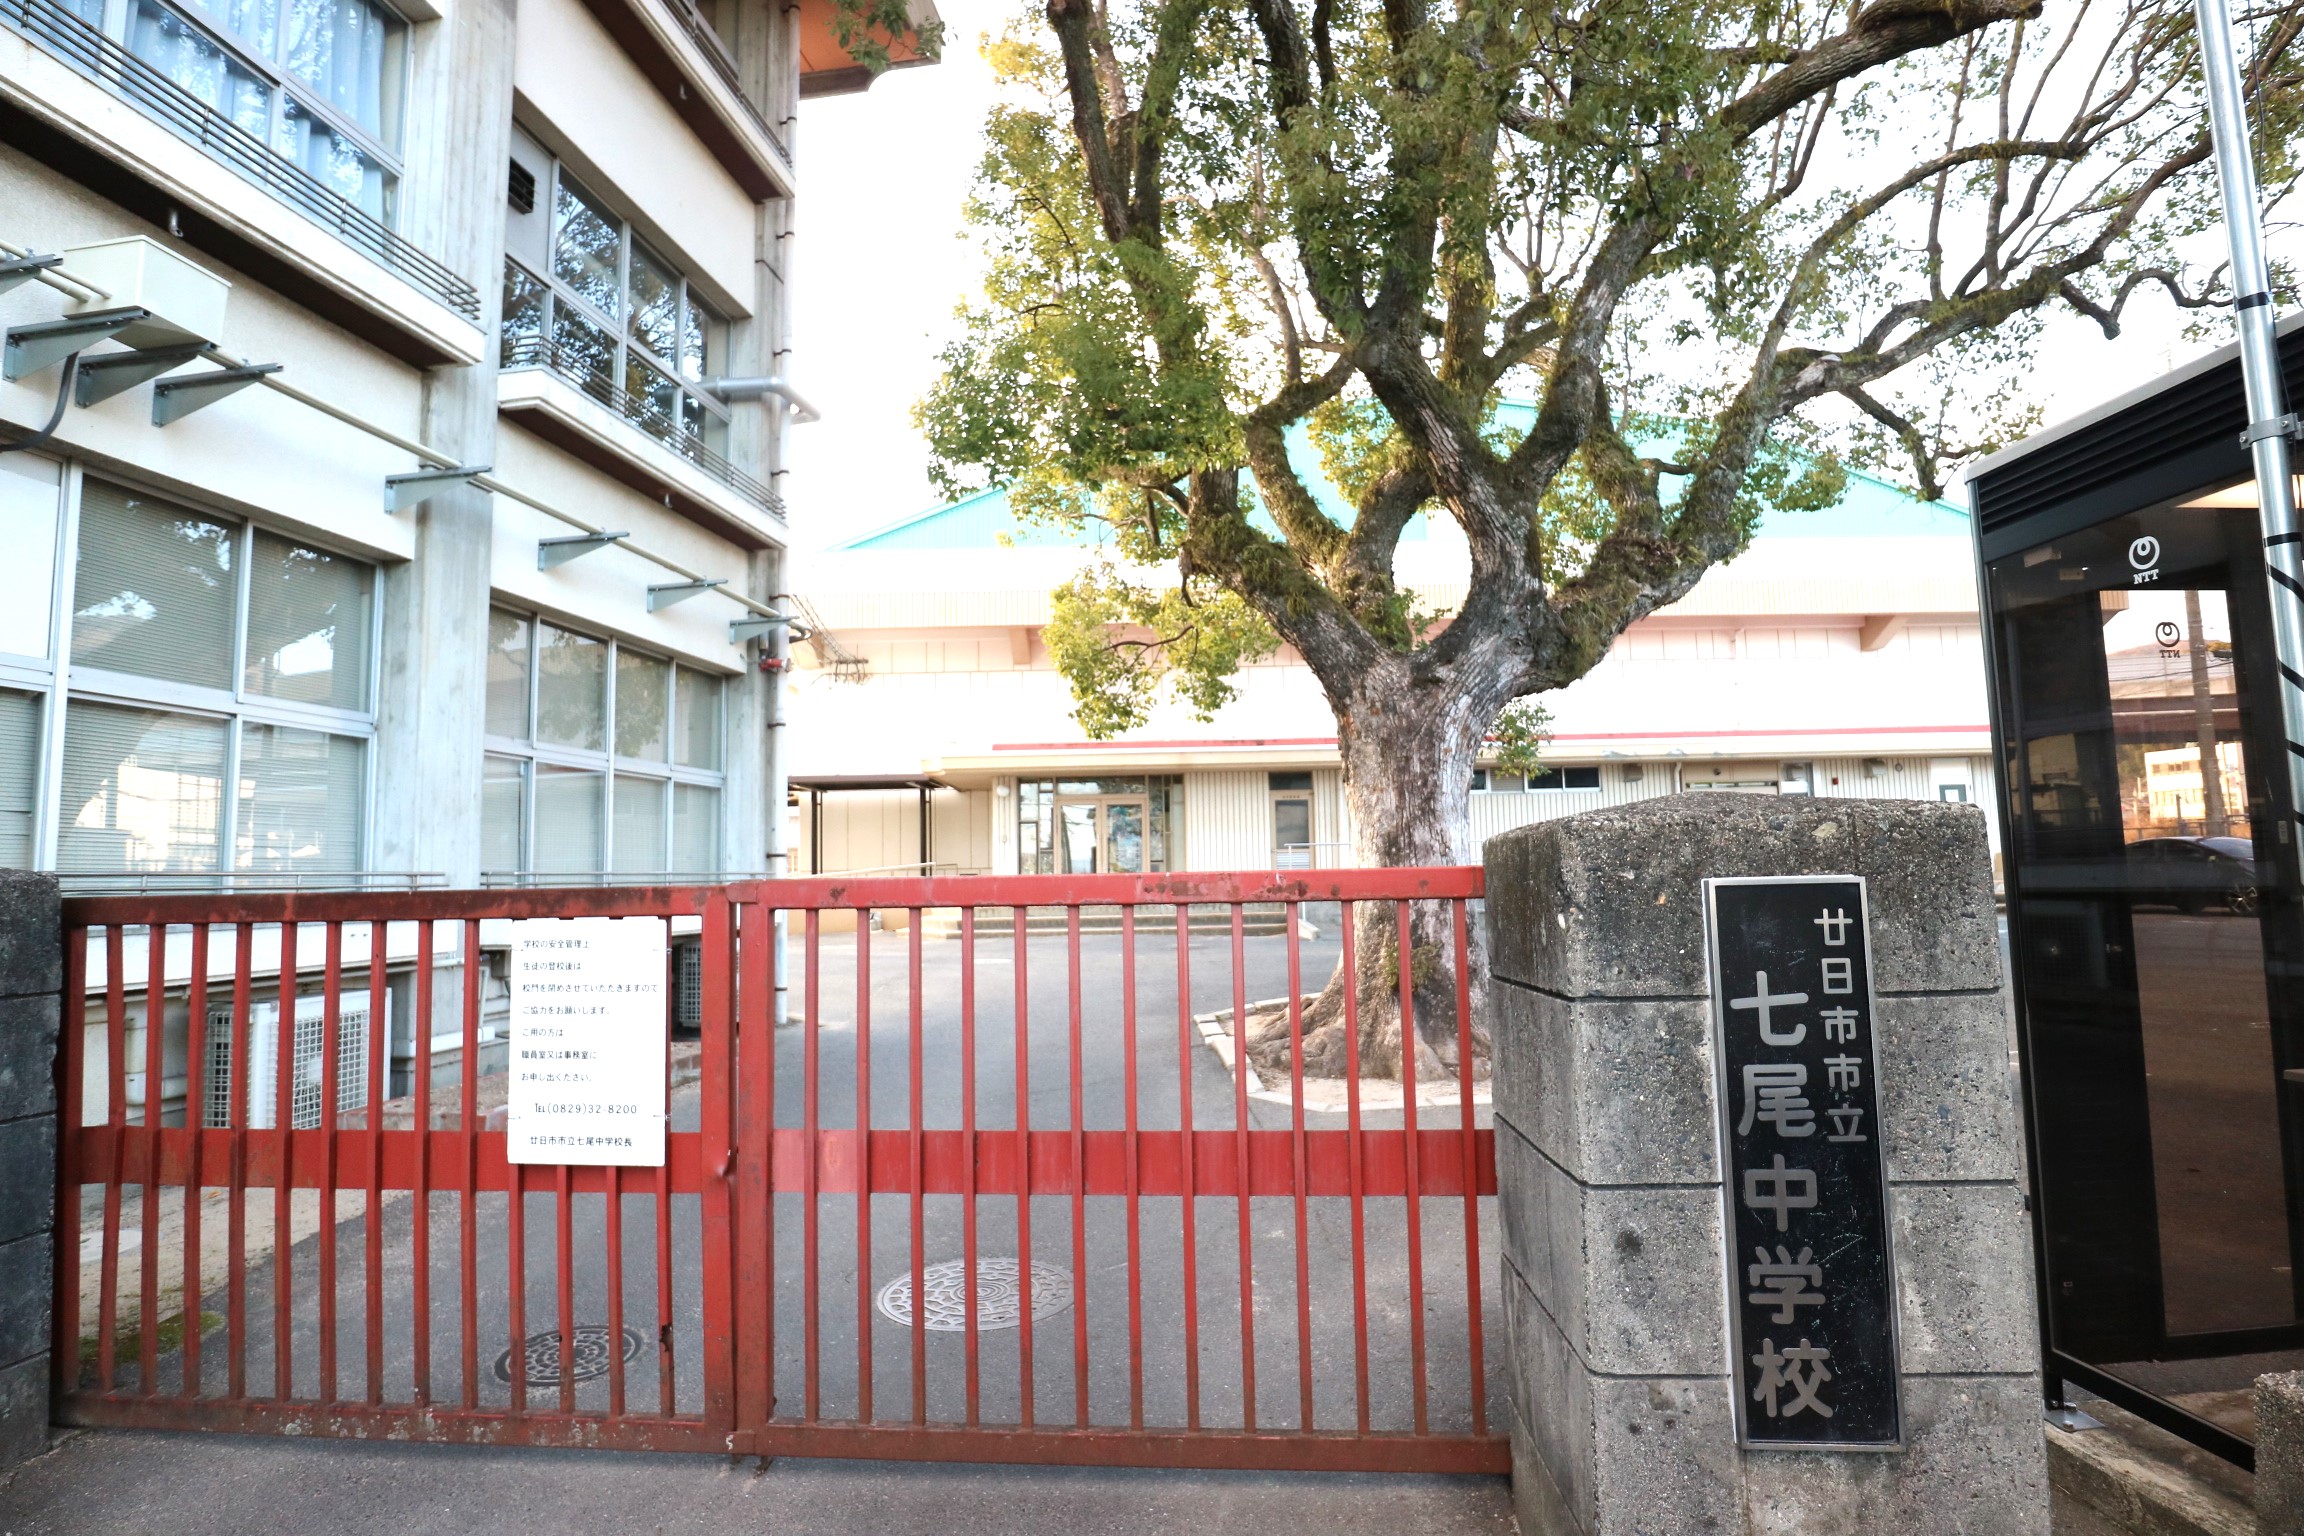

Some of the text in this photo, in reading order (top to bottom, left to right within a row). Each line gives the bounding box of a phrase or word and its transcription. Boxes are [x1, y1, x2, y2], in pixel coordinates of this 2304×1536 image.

[2133, 569, 2159, 584] NTT
[523, 939, 590, 949] 学校の安全管理上
[523, 961, 581, 971] 生徒の登校後は
[1813, 907, 1868, 1143] 廿日市市立
[521, 1049, 597, 1060] 職員室又は事務室に
[530, 1135, 633, 1147] 廿日市市立七尾中学校長
[1729, 970, 1835, 1419] 七尾中学校
